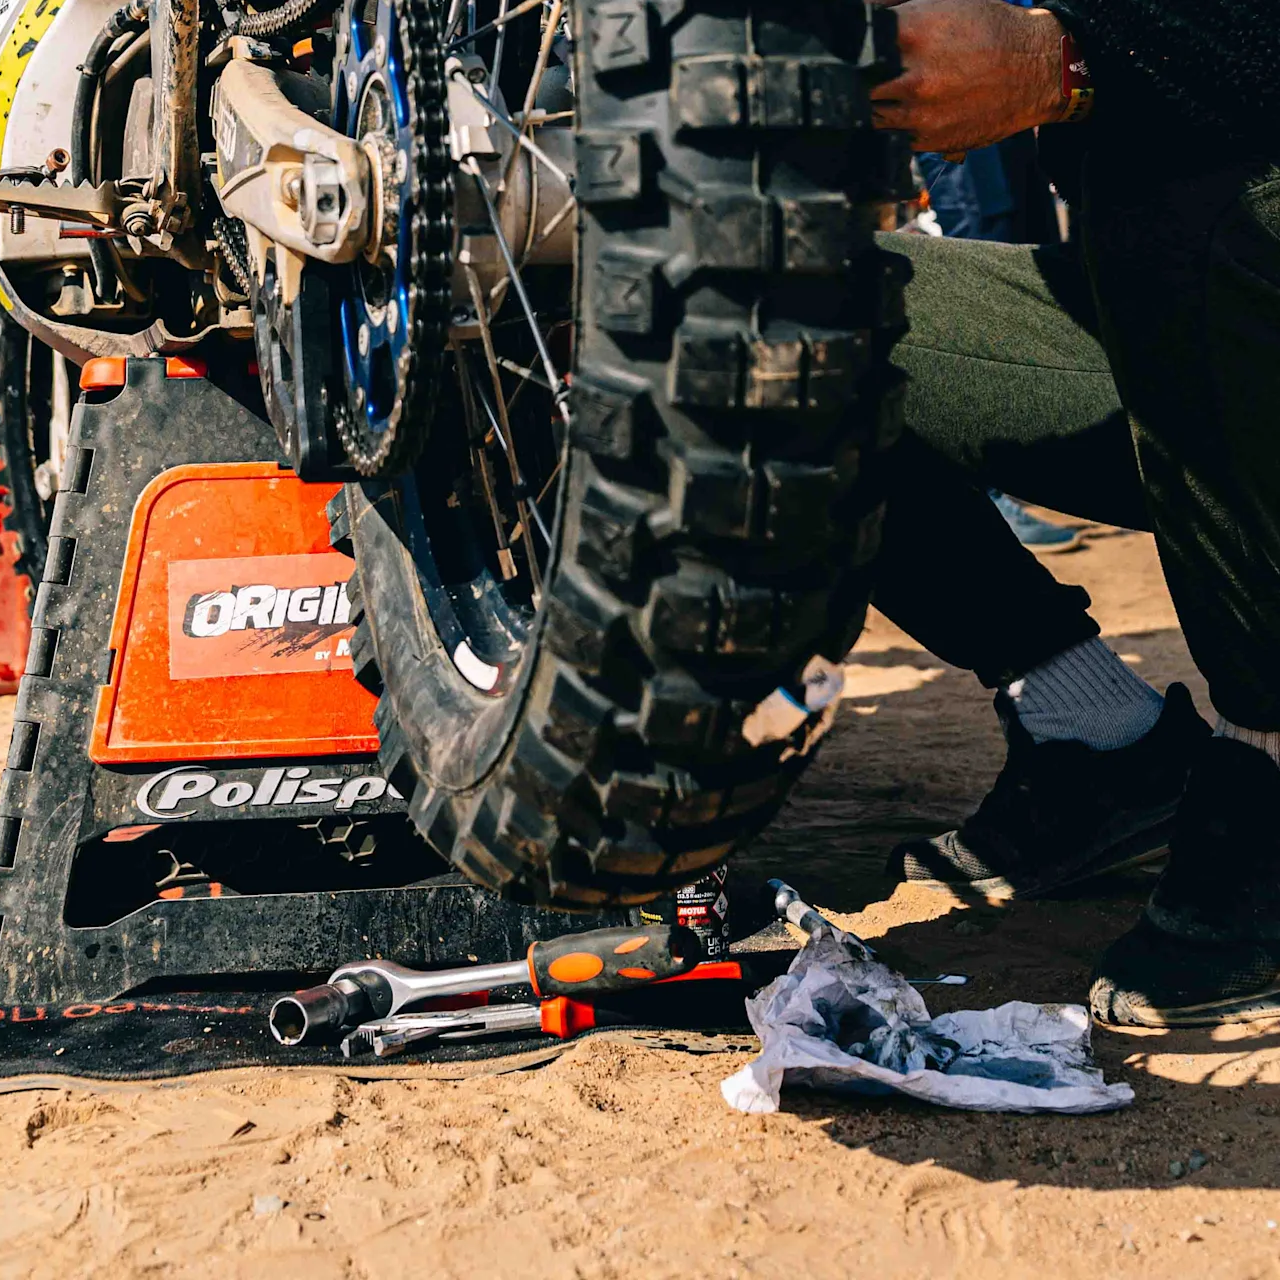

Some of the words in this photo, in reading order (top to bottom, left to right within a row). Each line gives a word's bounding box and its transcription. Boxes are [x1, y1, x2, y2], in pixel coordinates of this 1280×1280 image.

[315, 650, 331, 660] BY
[679, 907, 707, 915] MOTUL
[707, 936, 720, 947] UK
